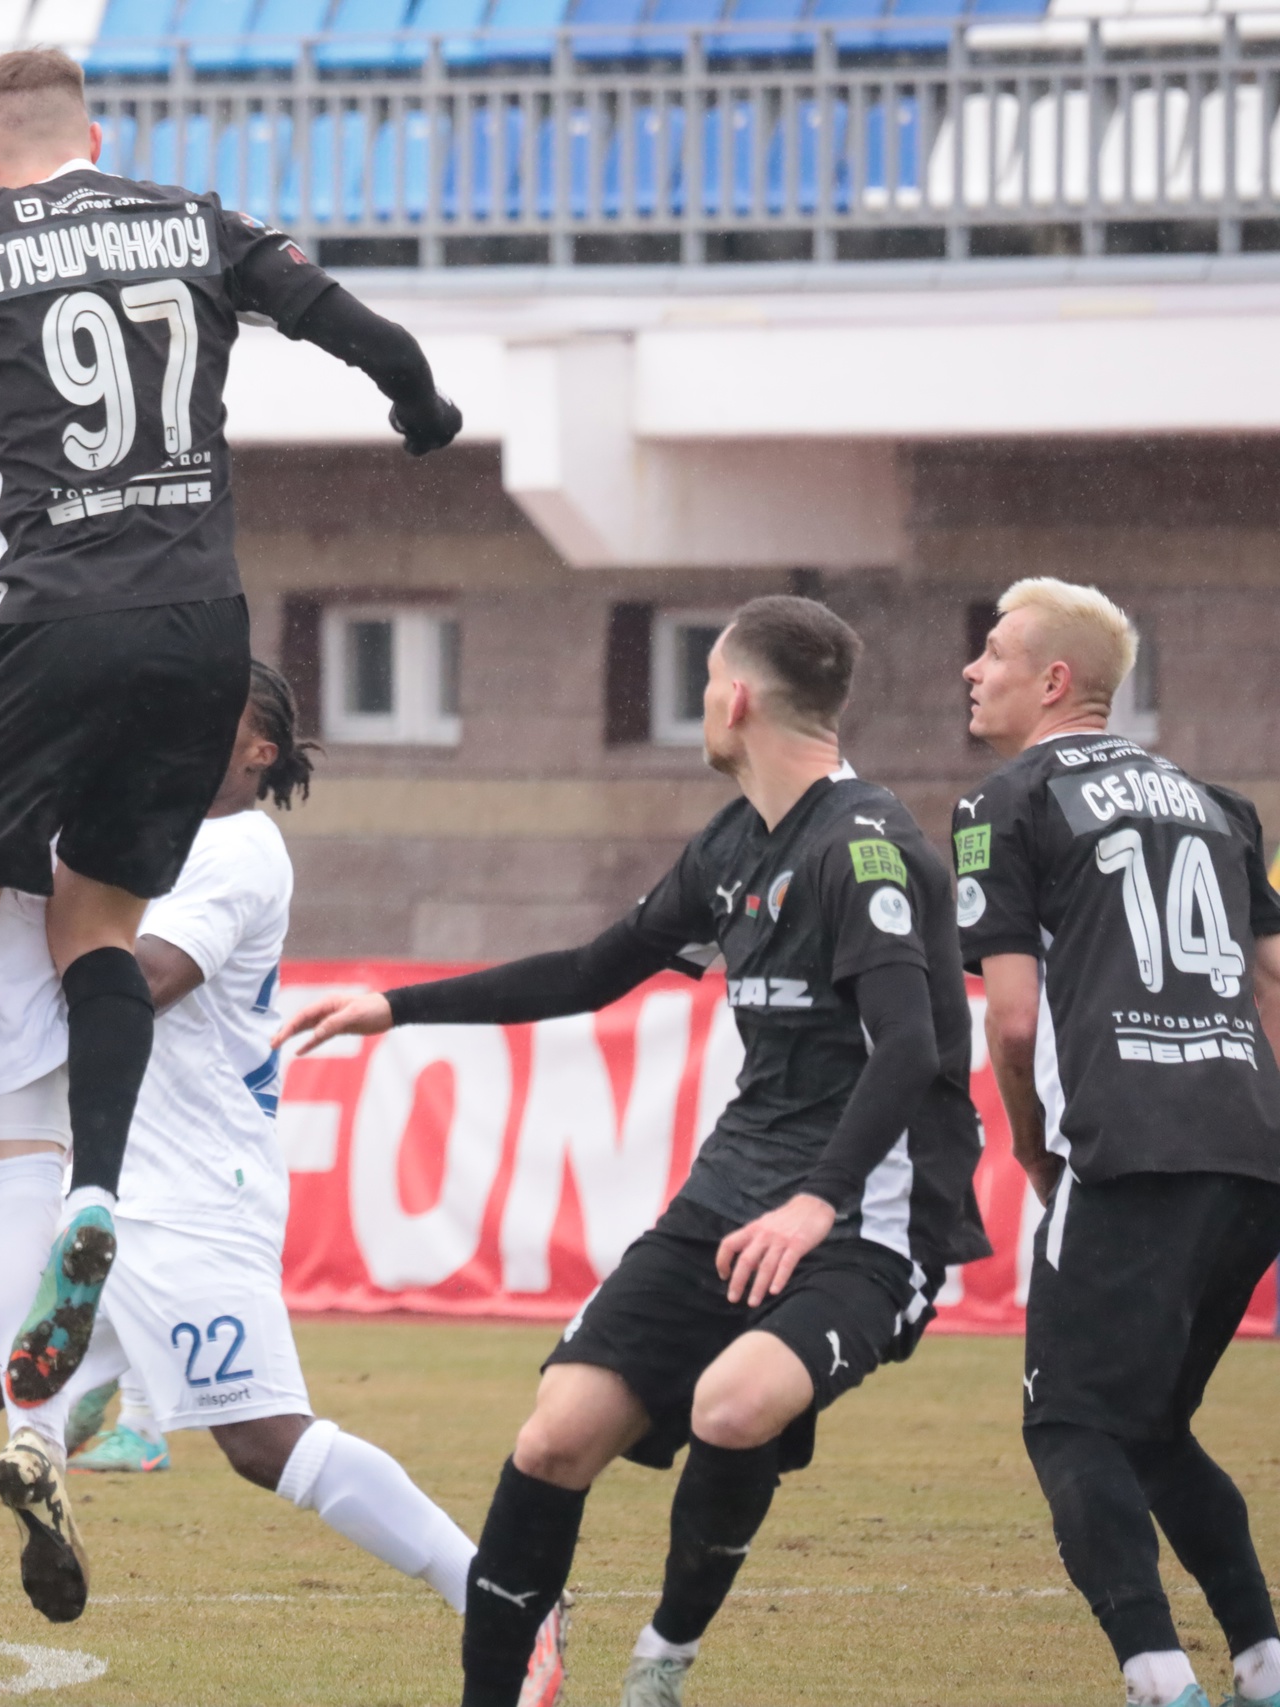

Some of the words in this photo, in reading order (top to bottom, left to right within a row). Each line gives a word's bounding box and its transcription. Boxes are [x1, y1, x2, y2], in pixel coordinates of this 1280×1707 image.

[42, 279, 199, 472] 97
[1081, 769, 1207, 823] СЕЛЯВА
[1096, 828, 1246, 998] 14
[1111, 1011, 1228, 1029] ТОРГОВЫЙ
[171, 1315, 253, 1388] 22
